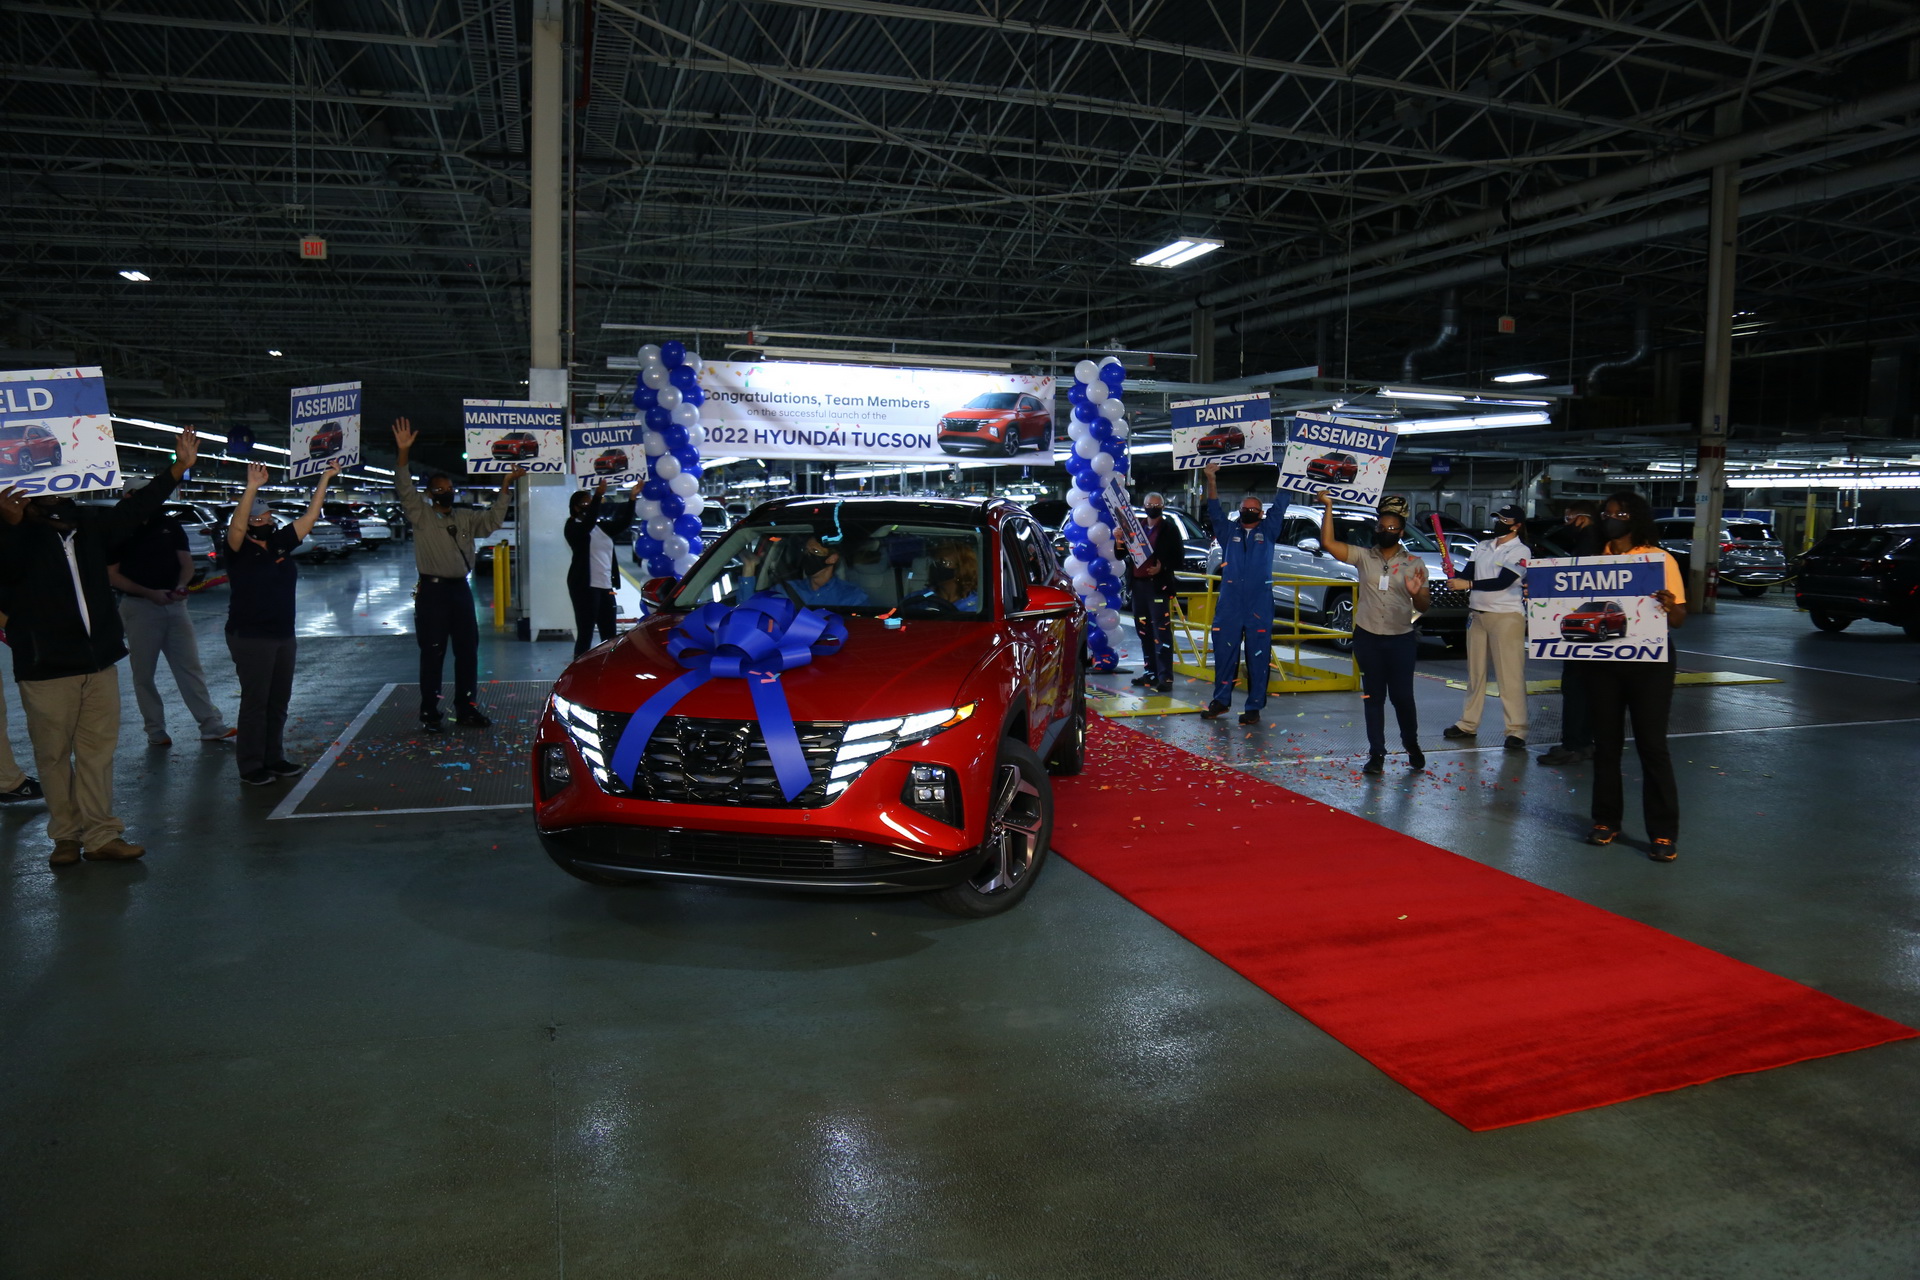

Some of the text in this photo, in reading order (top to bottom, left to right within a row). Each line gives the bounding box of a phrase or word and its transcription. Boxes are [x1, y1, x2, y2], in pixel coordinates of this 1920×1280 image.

[303, 241, 323, 257] EXIT
[0, 387, 54, 413] LD
[295, 393, 358, 419] ASSEMBLY
[703, 388, 931, 409] Congratulations, Team Members
[465, 411, 562, 426] MAINTENANCE
[746, 407, 888, 421] on the successful launch of the
[1195, 404, 1245, 423] PAINT
[581, 428, 633, 447] QUALITY
[703, 426, 932, 449] 2022 HYUNDAI TUCSON
[1296, 422, 1390, 452] ASSEMBLY
[1554, 569, 1634, 592] STAMP
[1530, 637, 1664, 661] TUCSON
